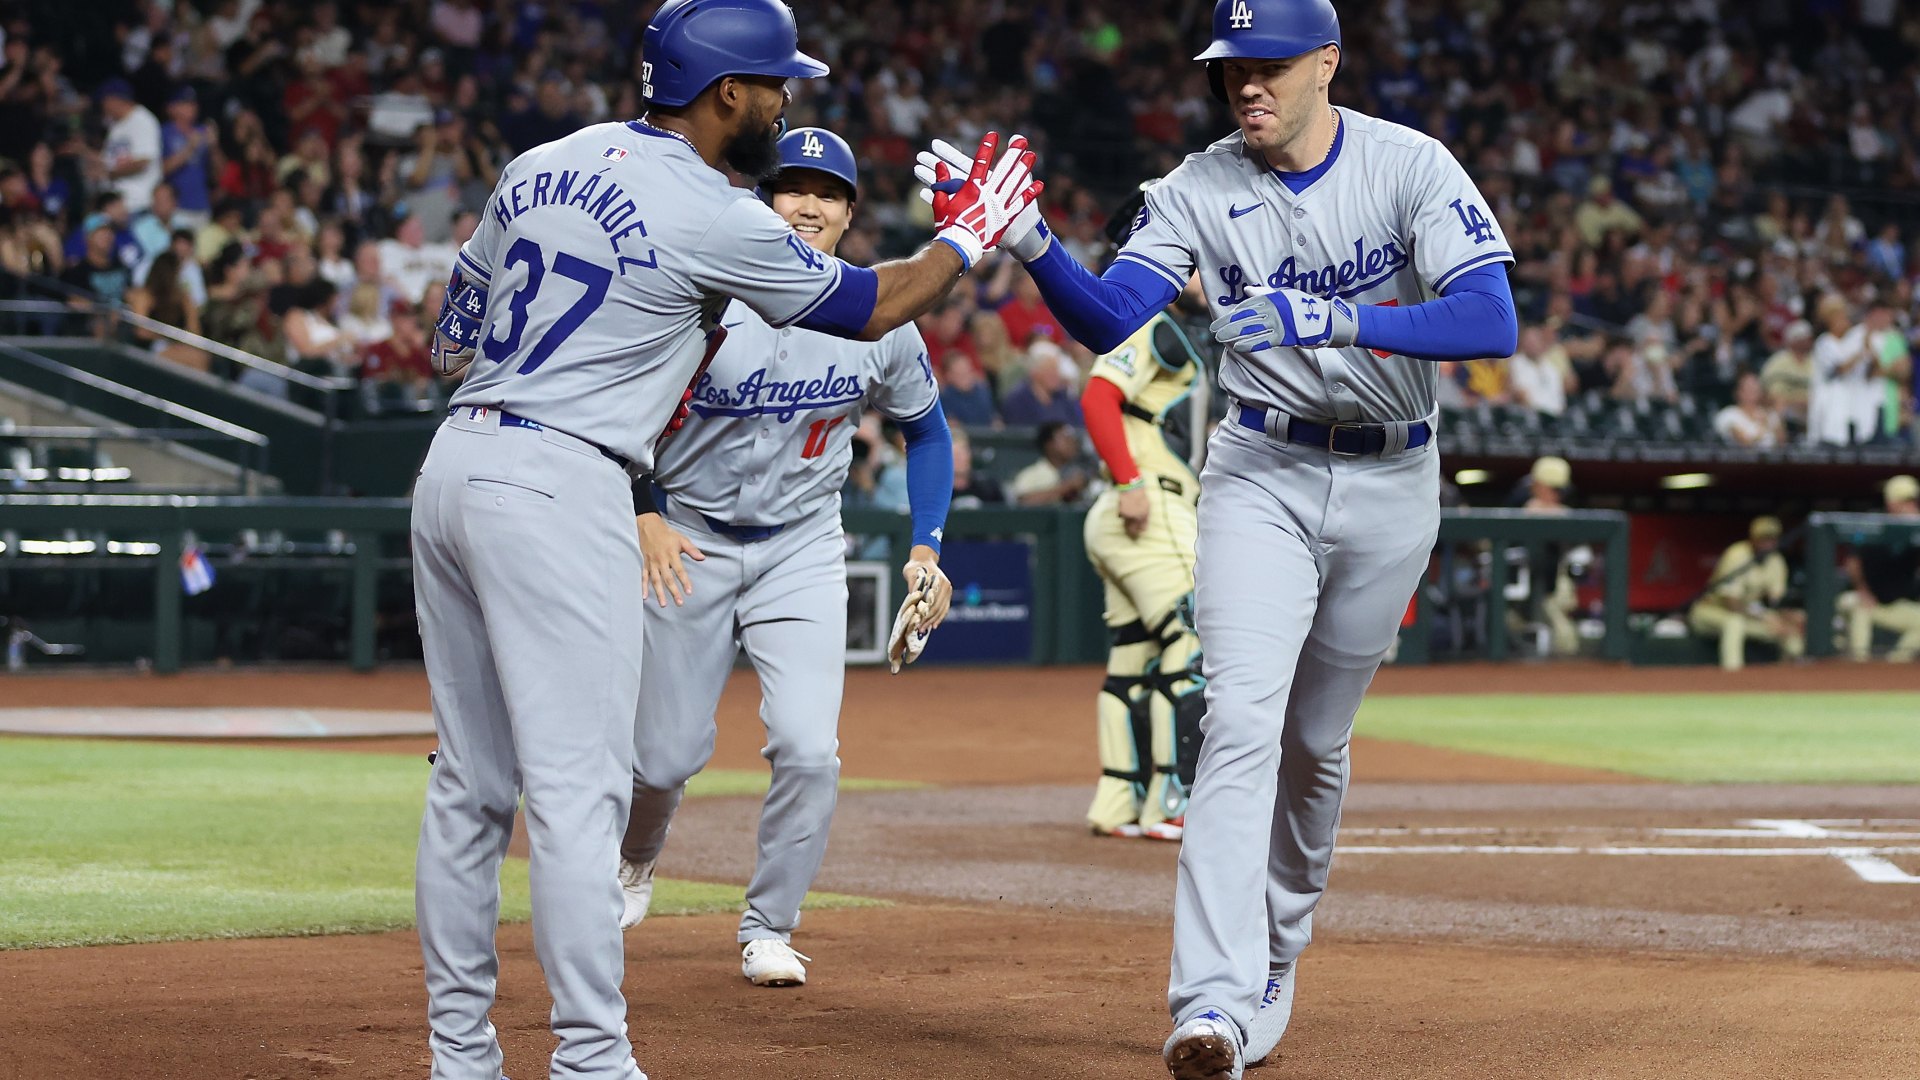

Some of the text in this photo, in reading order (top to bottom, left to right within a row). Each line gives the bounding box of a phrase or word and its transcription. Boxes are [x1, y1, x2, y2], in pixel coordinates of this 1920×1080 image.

[1229, 0, 1253, 29] LA
[642, 61, 653, 83] 37
[801, 131, 824, 158] LA
[494, 167, 658, 277] HERNÁNDEZ
[1448, 198, 1497, 245] LA
[1267, 235, 1409, 300] Angeles
[466, 289, 482, 314] LA
[481, 237, 614, 376] 37
[449, 314, 463, 340] LA
[690, 364, 864, 424] Los Angeles
